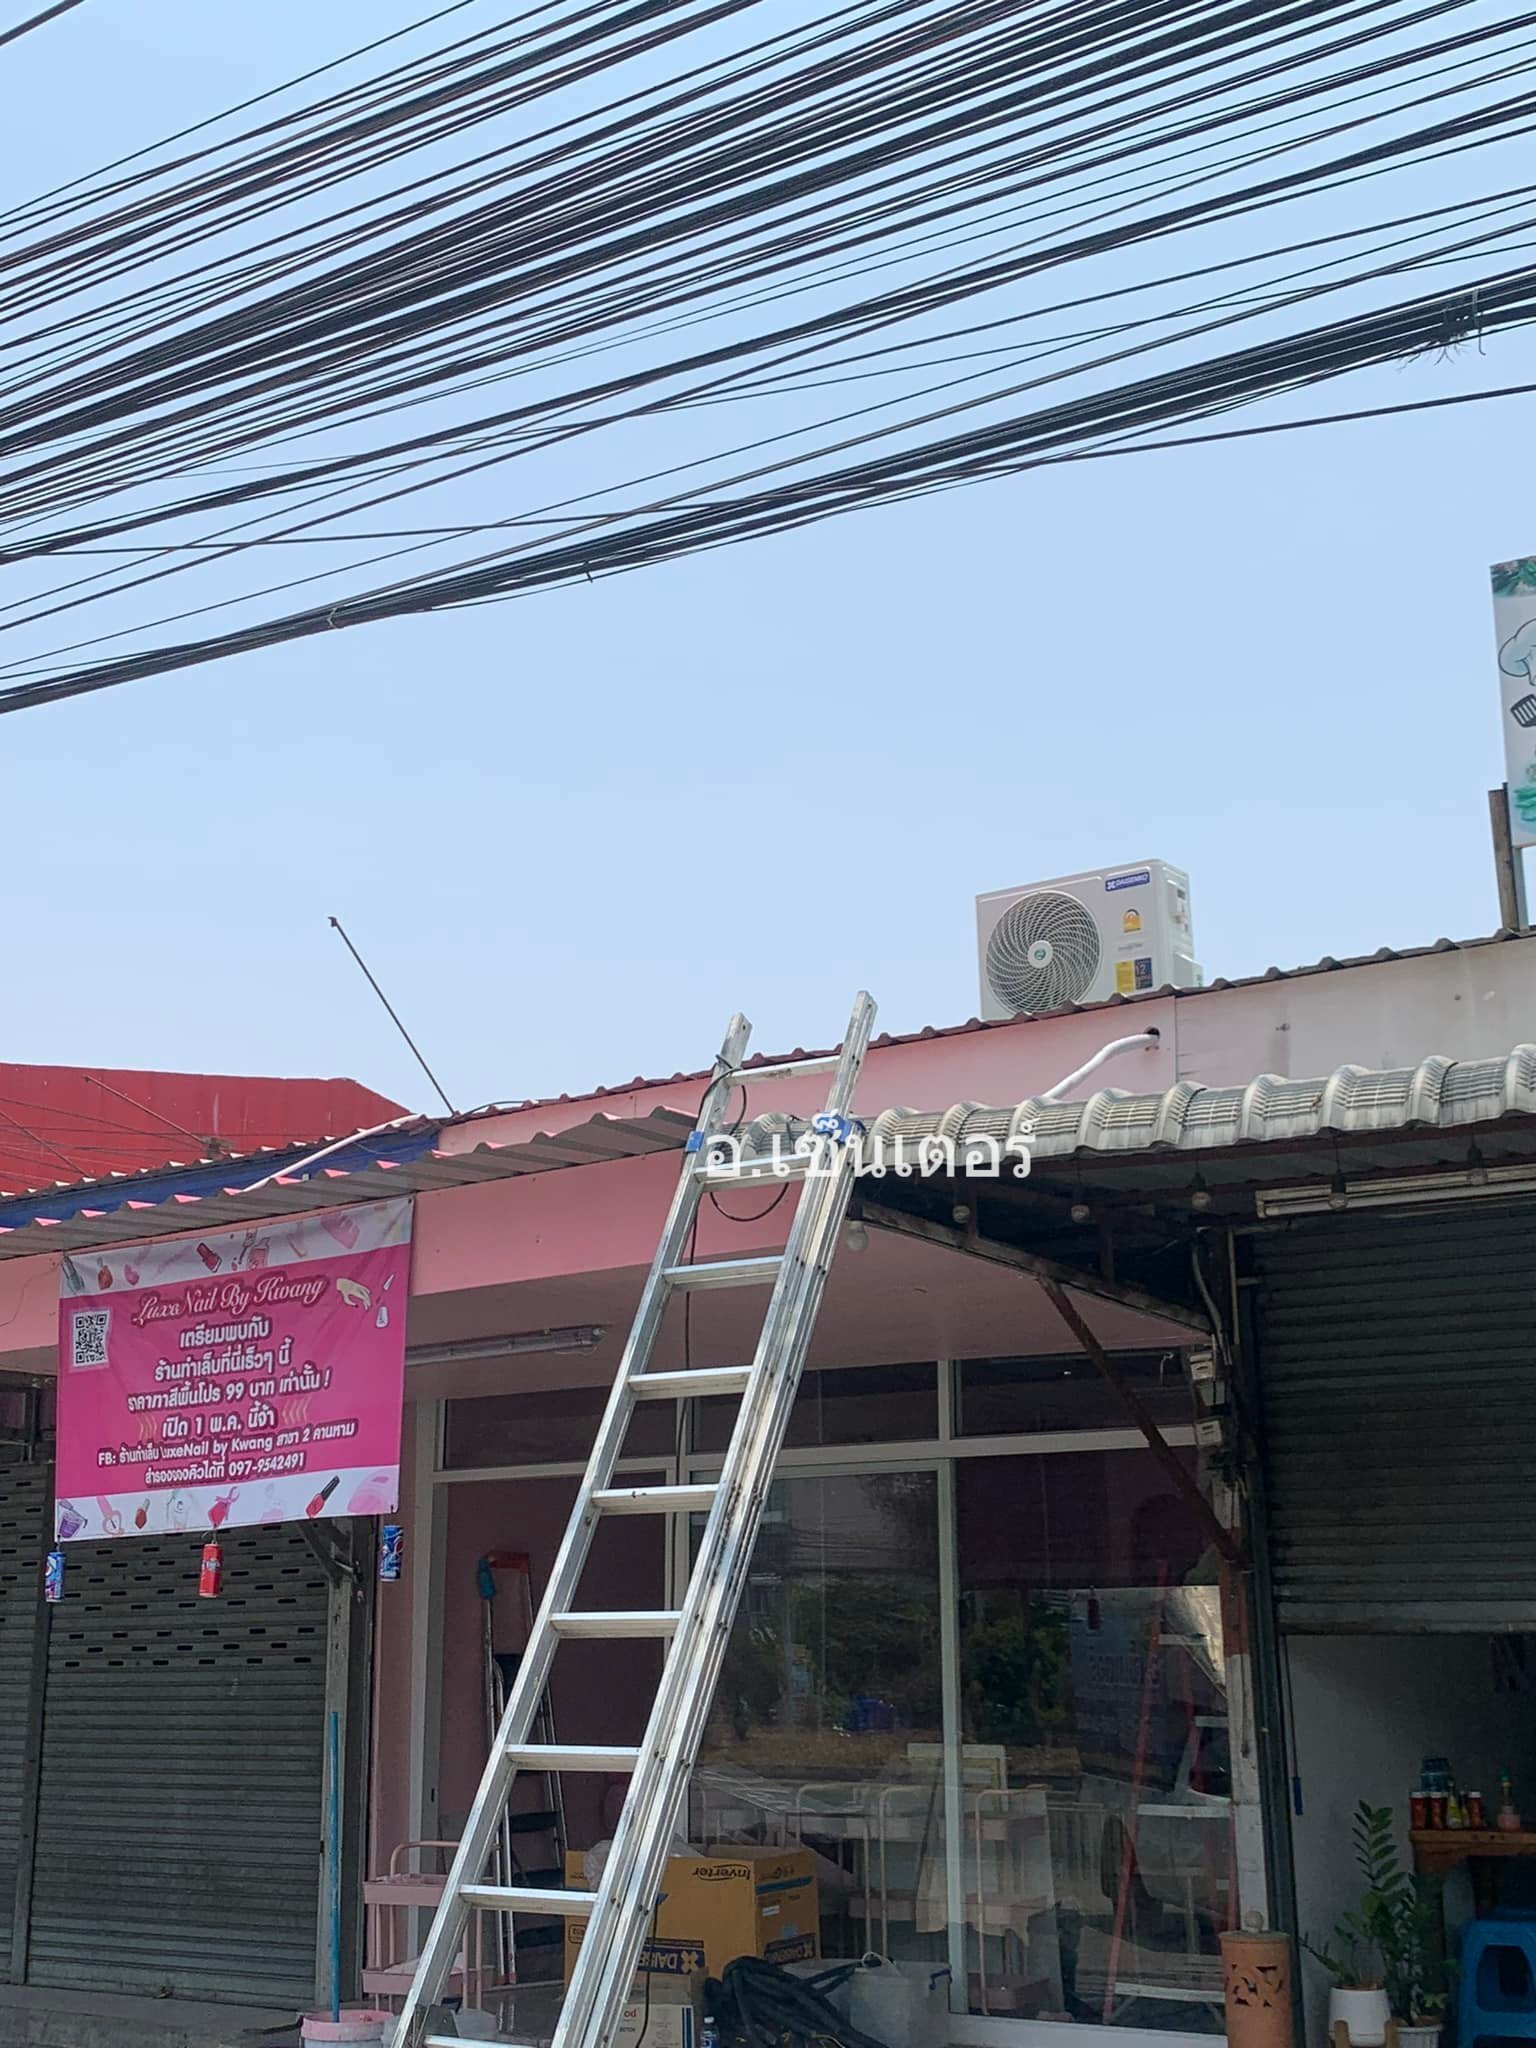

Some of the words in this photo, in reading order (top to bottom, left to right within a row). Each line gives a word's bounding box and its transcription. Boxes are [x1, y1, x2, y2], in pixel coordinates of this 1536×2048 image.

[220, 1283, 250, 1315] By
[254, 1276, 323, 1304] Kwang
[180, 1316, 269, 1348] เตรียมพบกับ
[226, 1383, 244, 1400] 99
[250, 1380, 274, 1397] บาท
[279, 1363, 321, 1393] เท่านั้น
[162, 1416, 188, 1438] เปิด
[195, 1416, 202, 1434] 1
[210, 1414, 241, 1433] พ.ค.
[248, 1400, 275, 1428] นี้จ้า
[98, 1451, 116, 1466] FB:
[213, 1438, 228, 1457] by
[231, 1436, 273, 1452] Kwang
[302, 1427, 310, 1442] 2
[228, 1452, 305, 1476] 097-9542491
[692, 1865, 750, 1881] Inverter
